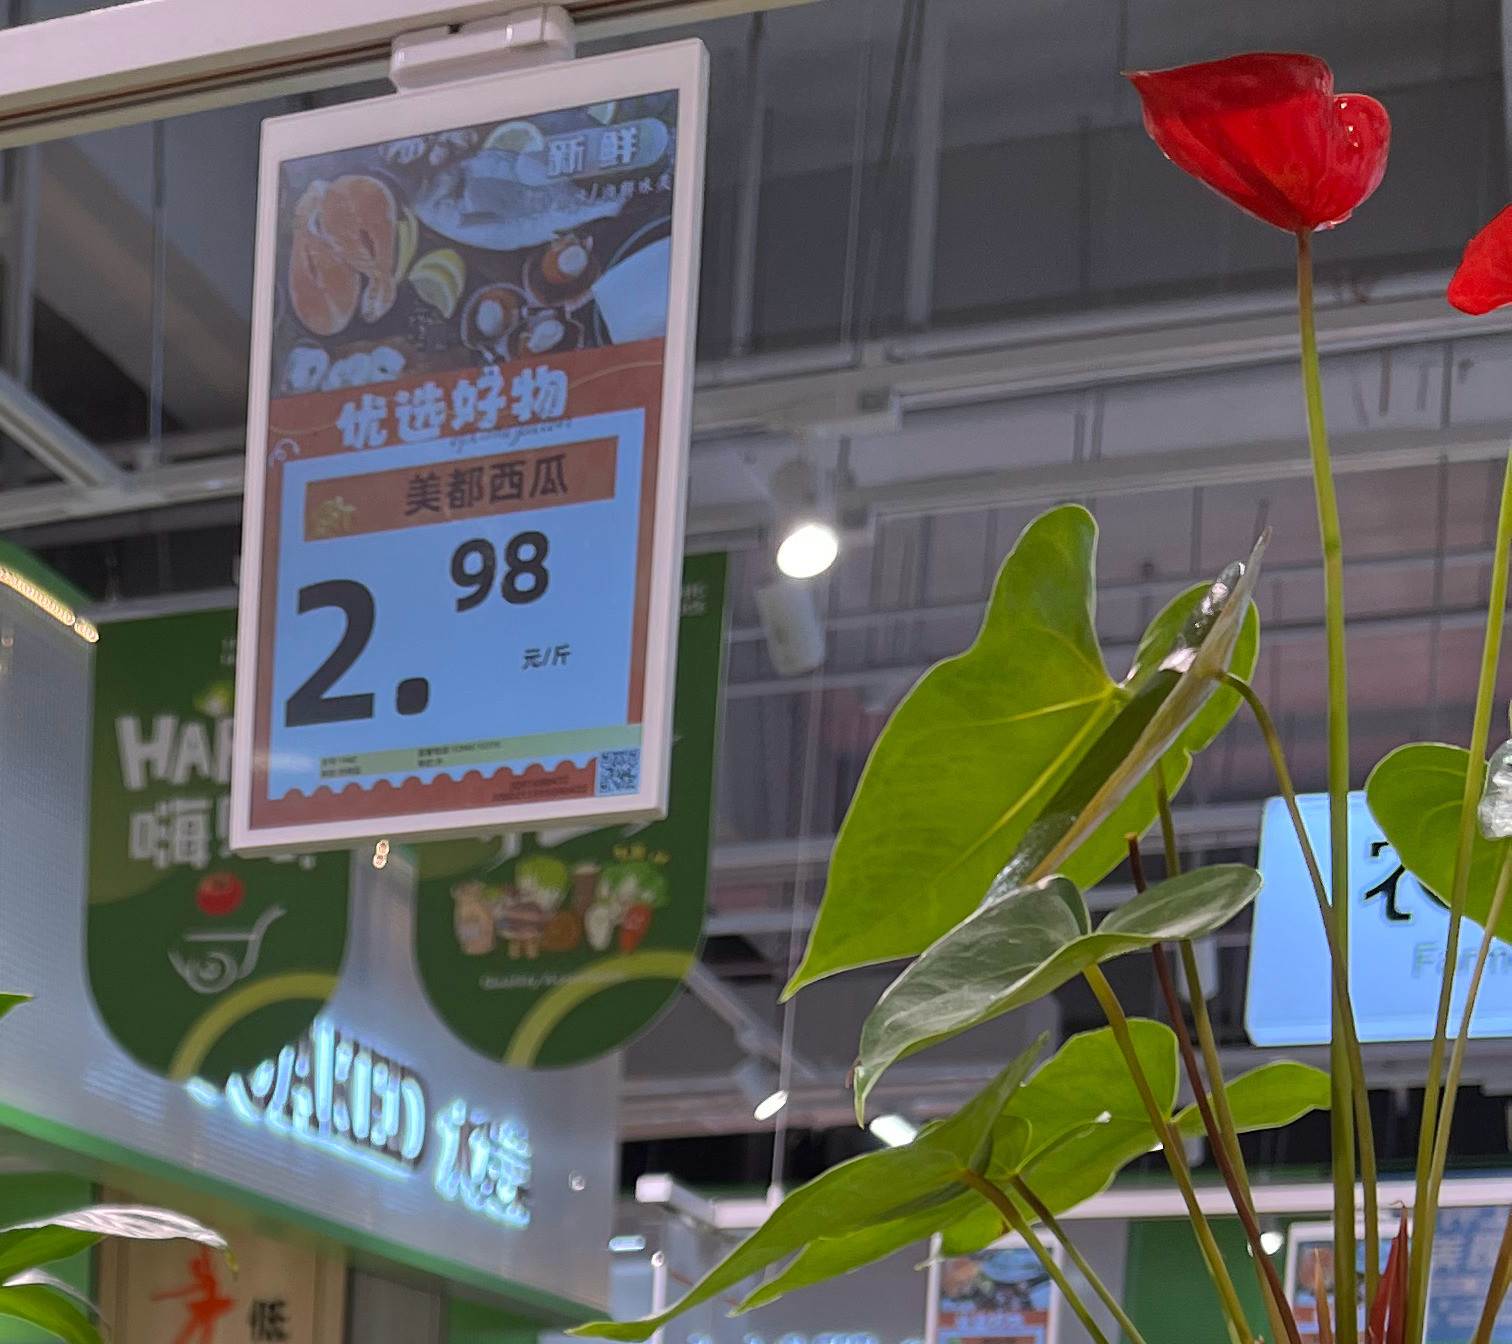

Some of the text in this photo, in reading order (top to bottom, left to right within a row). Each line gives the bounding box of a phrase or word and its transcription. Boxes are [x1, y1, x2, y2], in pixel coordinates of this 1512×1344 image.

[547, 127, 639, 179] 新鲜
[336, 365, 569, 449] 优选好物
[404, 453, 569, 517] 美都西瓜
[449, 531, 550, 613] 98
[522, 643, 571, 671] 元/斤
